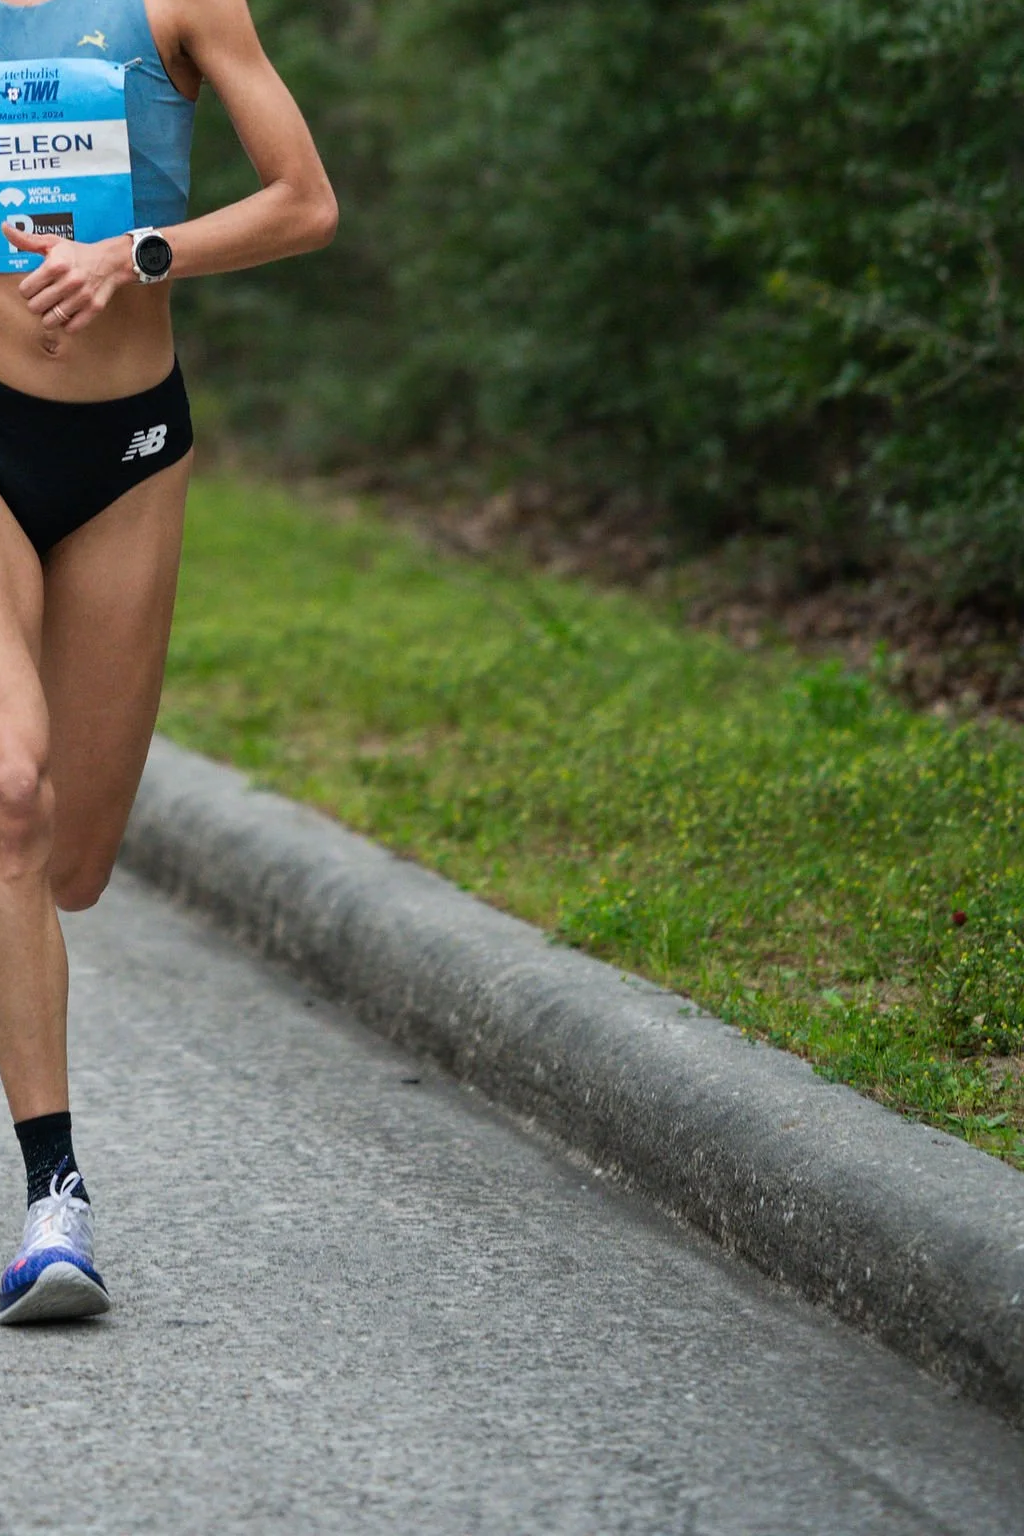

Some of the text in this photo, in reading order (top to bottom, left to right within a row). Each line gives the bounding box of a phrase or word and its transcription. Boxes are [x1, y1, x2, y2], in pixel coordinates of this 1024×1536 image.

[0, 112, 28, 120] March
[9, 157, 61, 171] ELITE
[27, 186, 60, 195] WORLD
[35, 225, 73, 233] RENKEN
